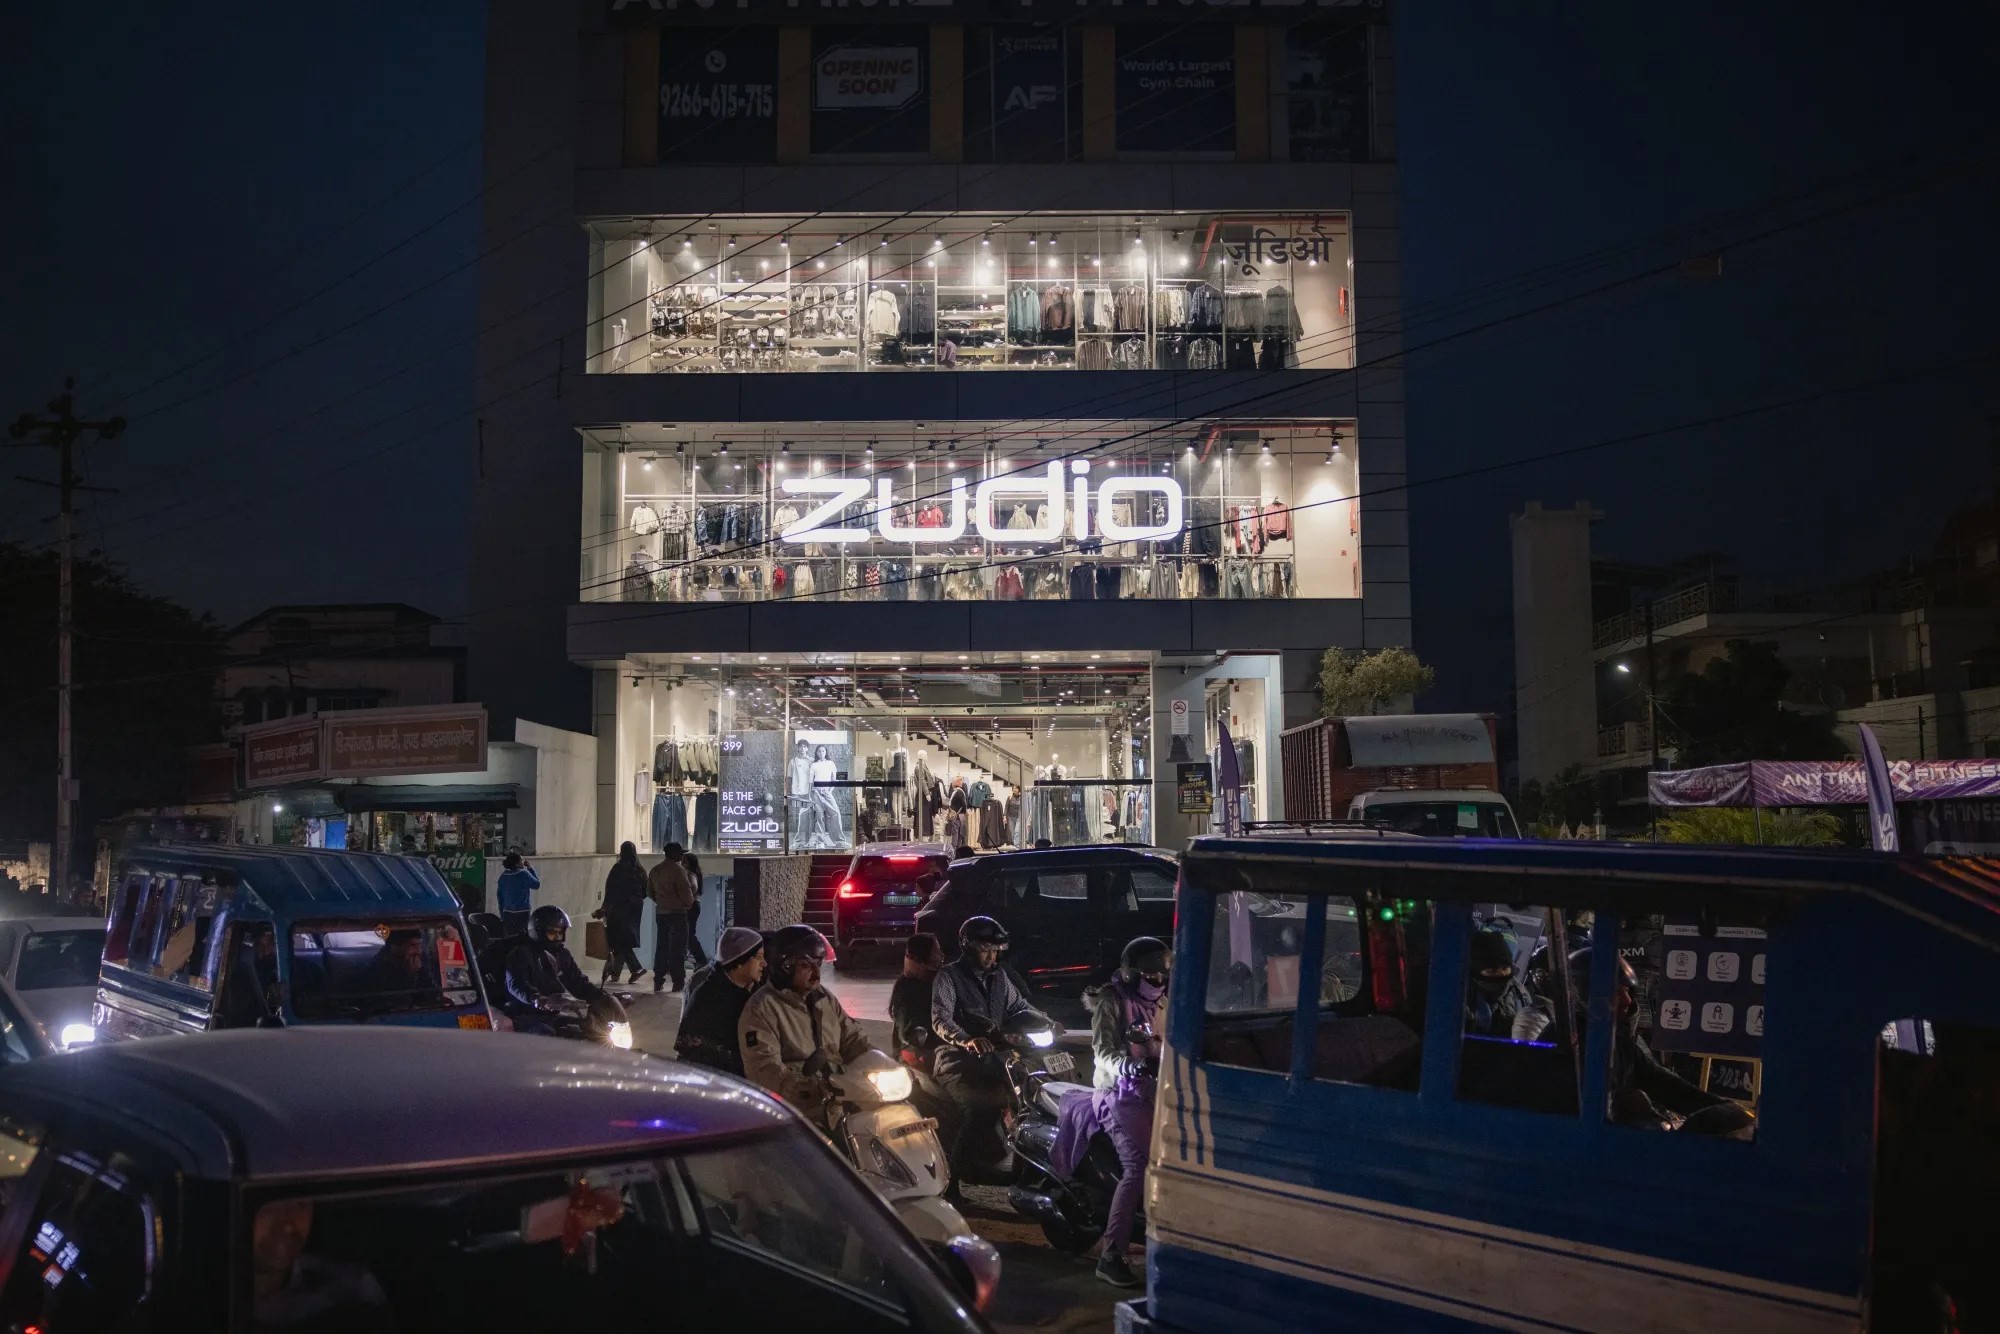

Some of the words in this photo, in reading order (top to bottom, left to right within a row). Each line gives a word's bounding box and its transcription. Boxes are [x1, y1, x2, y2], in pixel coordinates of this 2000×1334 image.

[822, 58, 914, 77] OPENING
[1122, 60, 1176, 73] World's
[1178, 60, 1232, 75] Largest
[837, 77, 896, 95] SOON
[1139, 77, 1170, 91] Gym
[1174, 76, 1216, 89] Chain
[660, 83, 774, 118] 9266-615-715
[1003, 85, 1057, 110] AF
[780, 458, 1184, 544] zudio
[1782, 772, 1866, 788] ANYTIM
[722, 791, 734, 801] BE
[737, 791, 754, 801] THE
[722, 805, 746, 815] FACE
[748, 805, 762, 815] OF
[1943, 802, 2000, 822] FITNES
[721, 819, 779, 833] zudio
